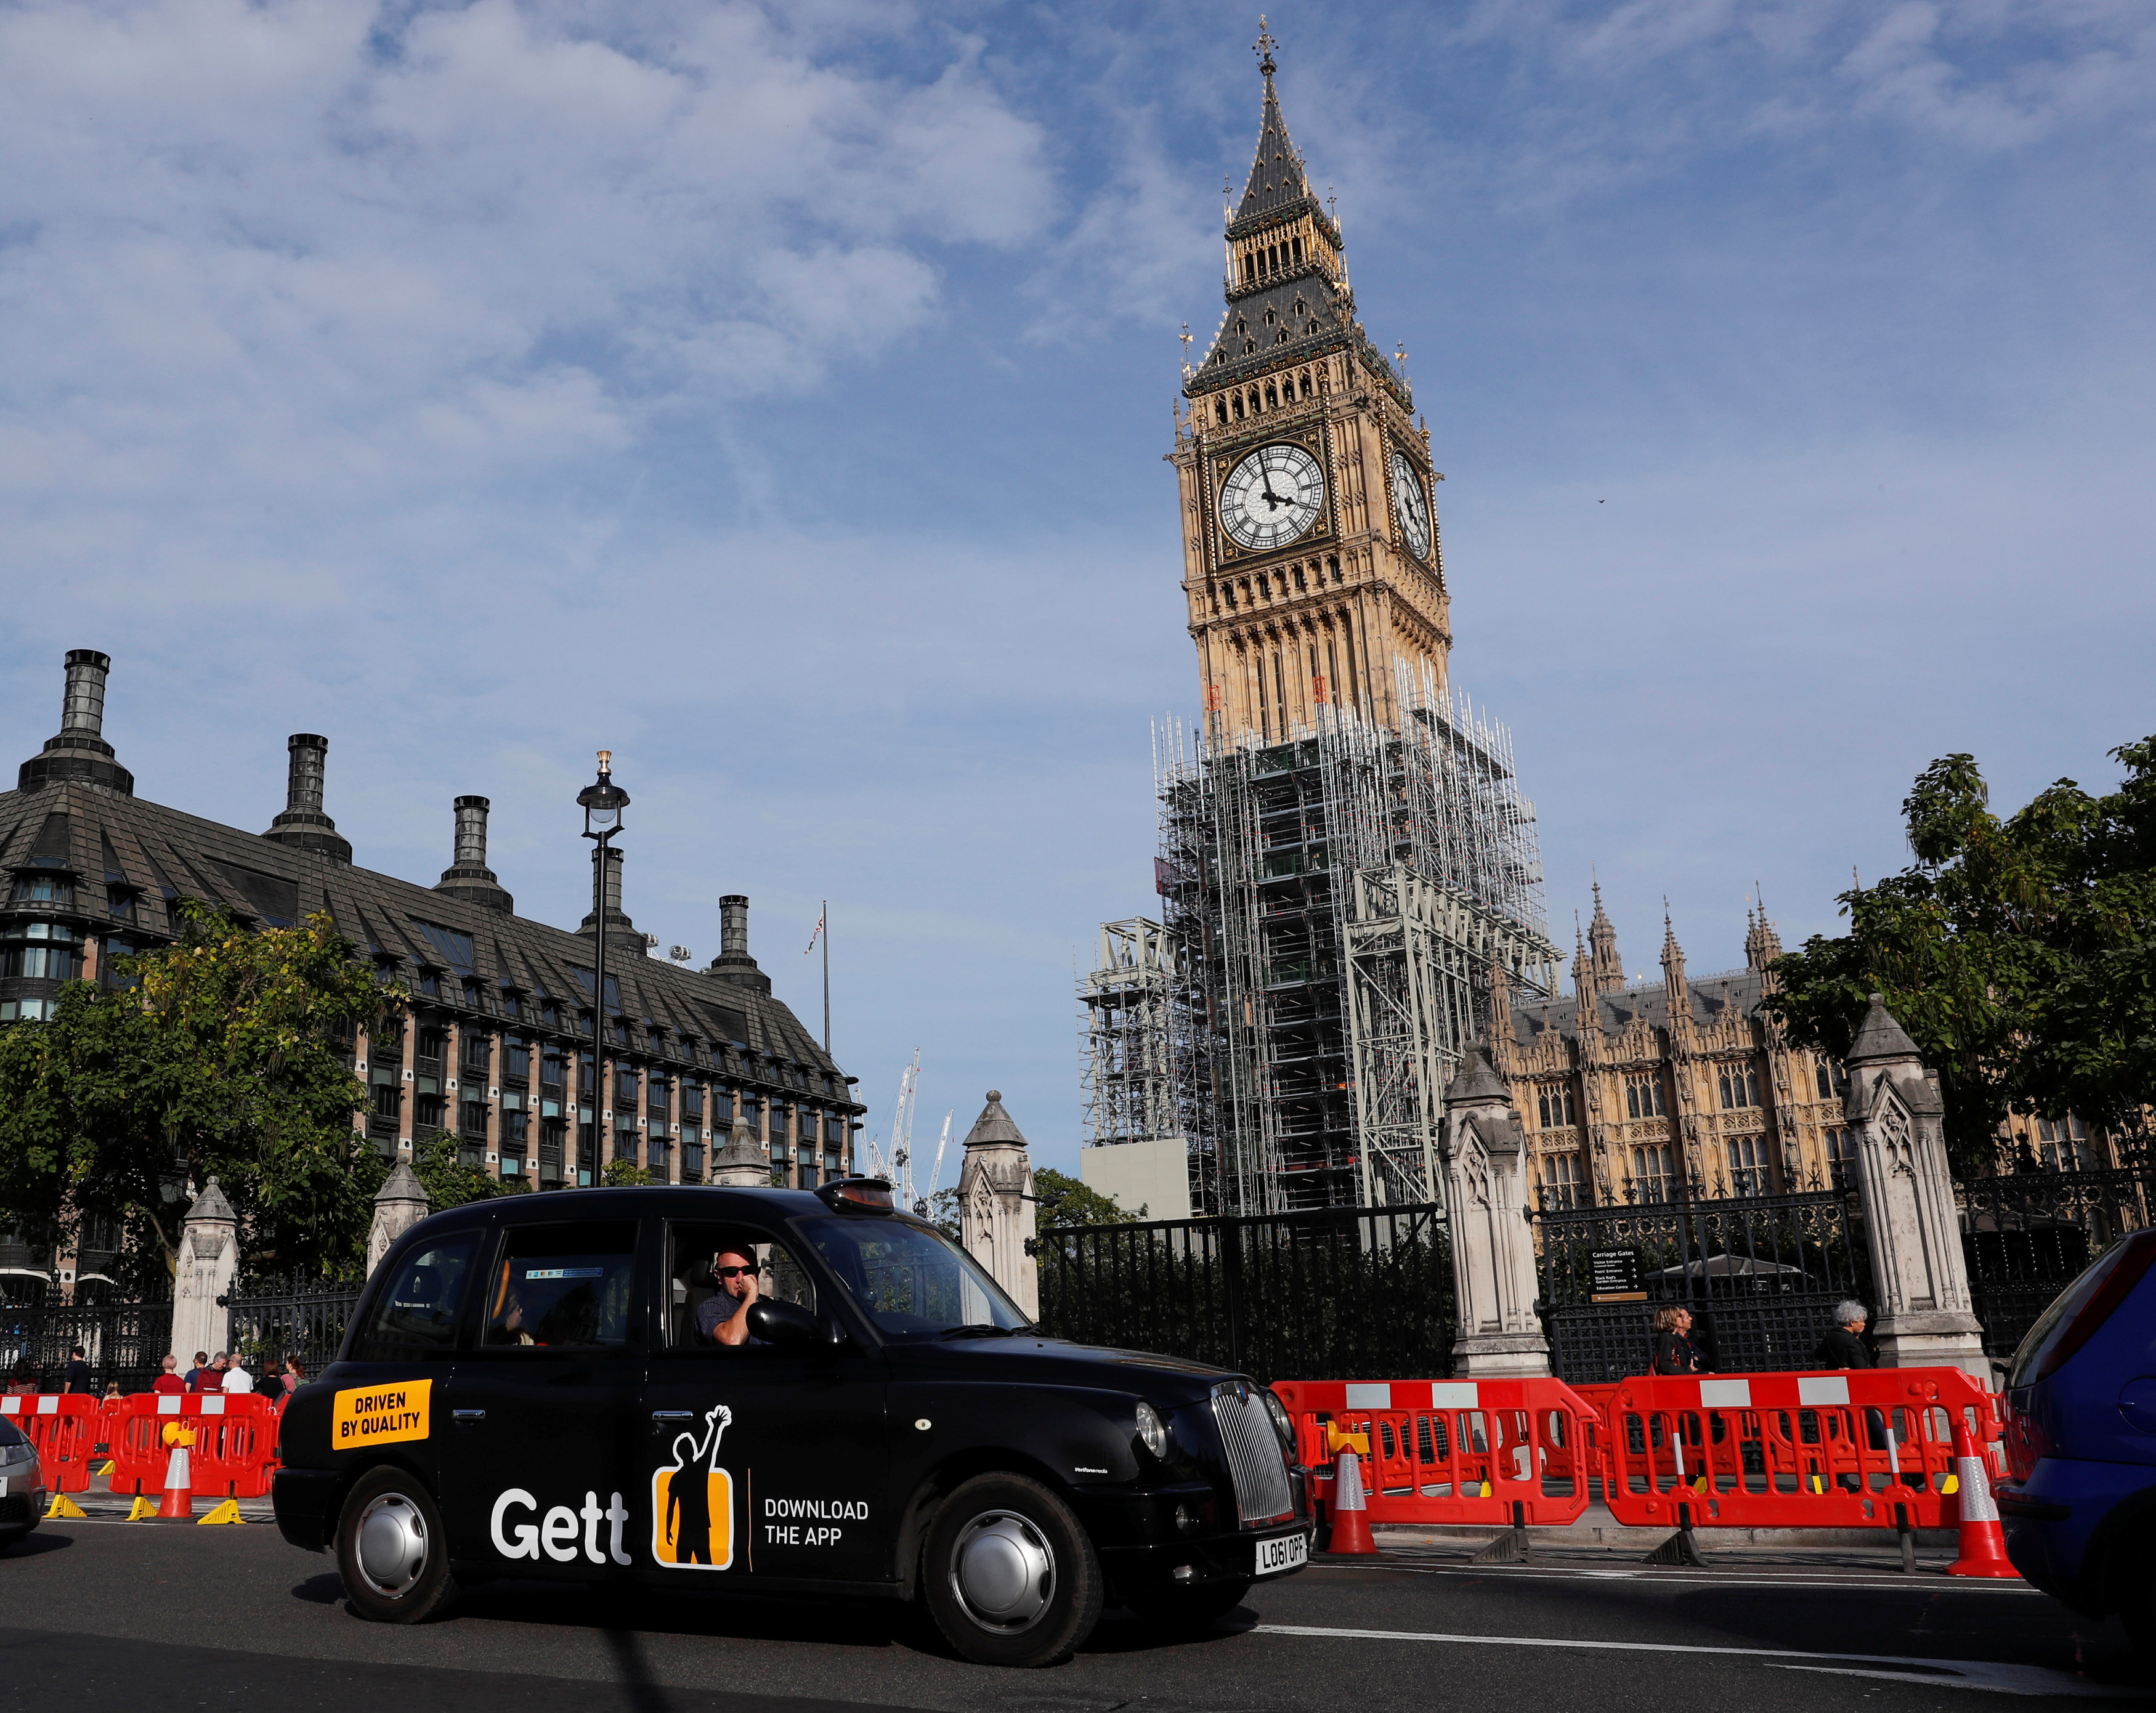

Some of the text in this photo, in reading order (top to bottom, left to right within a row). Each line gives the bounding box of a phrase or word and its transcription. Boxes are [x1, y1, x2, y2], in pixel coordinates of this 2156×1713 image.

[355, 1391, 406, 1414] DRIVEN
[341, 1412, 420, 1438] BY QUALITY
[764, 1499, 869, 1520] DOWNLOAD
[491, 1488, 632, 1565] Gett
[764, 1525, 842, 1546] THE APP
